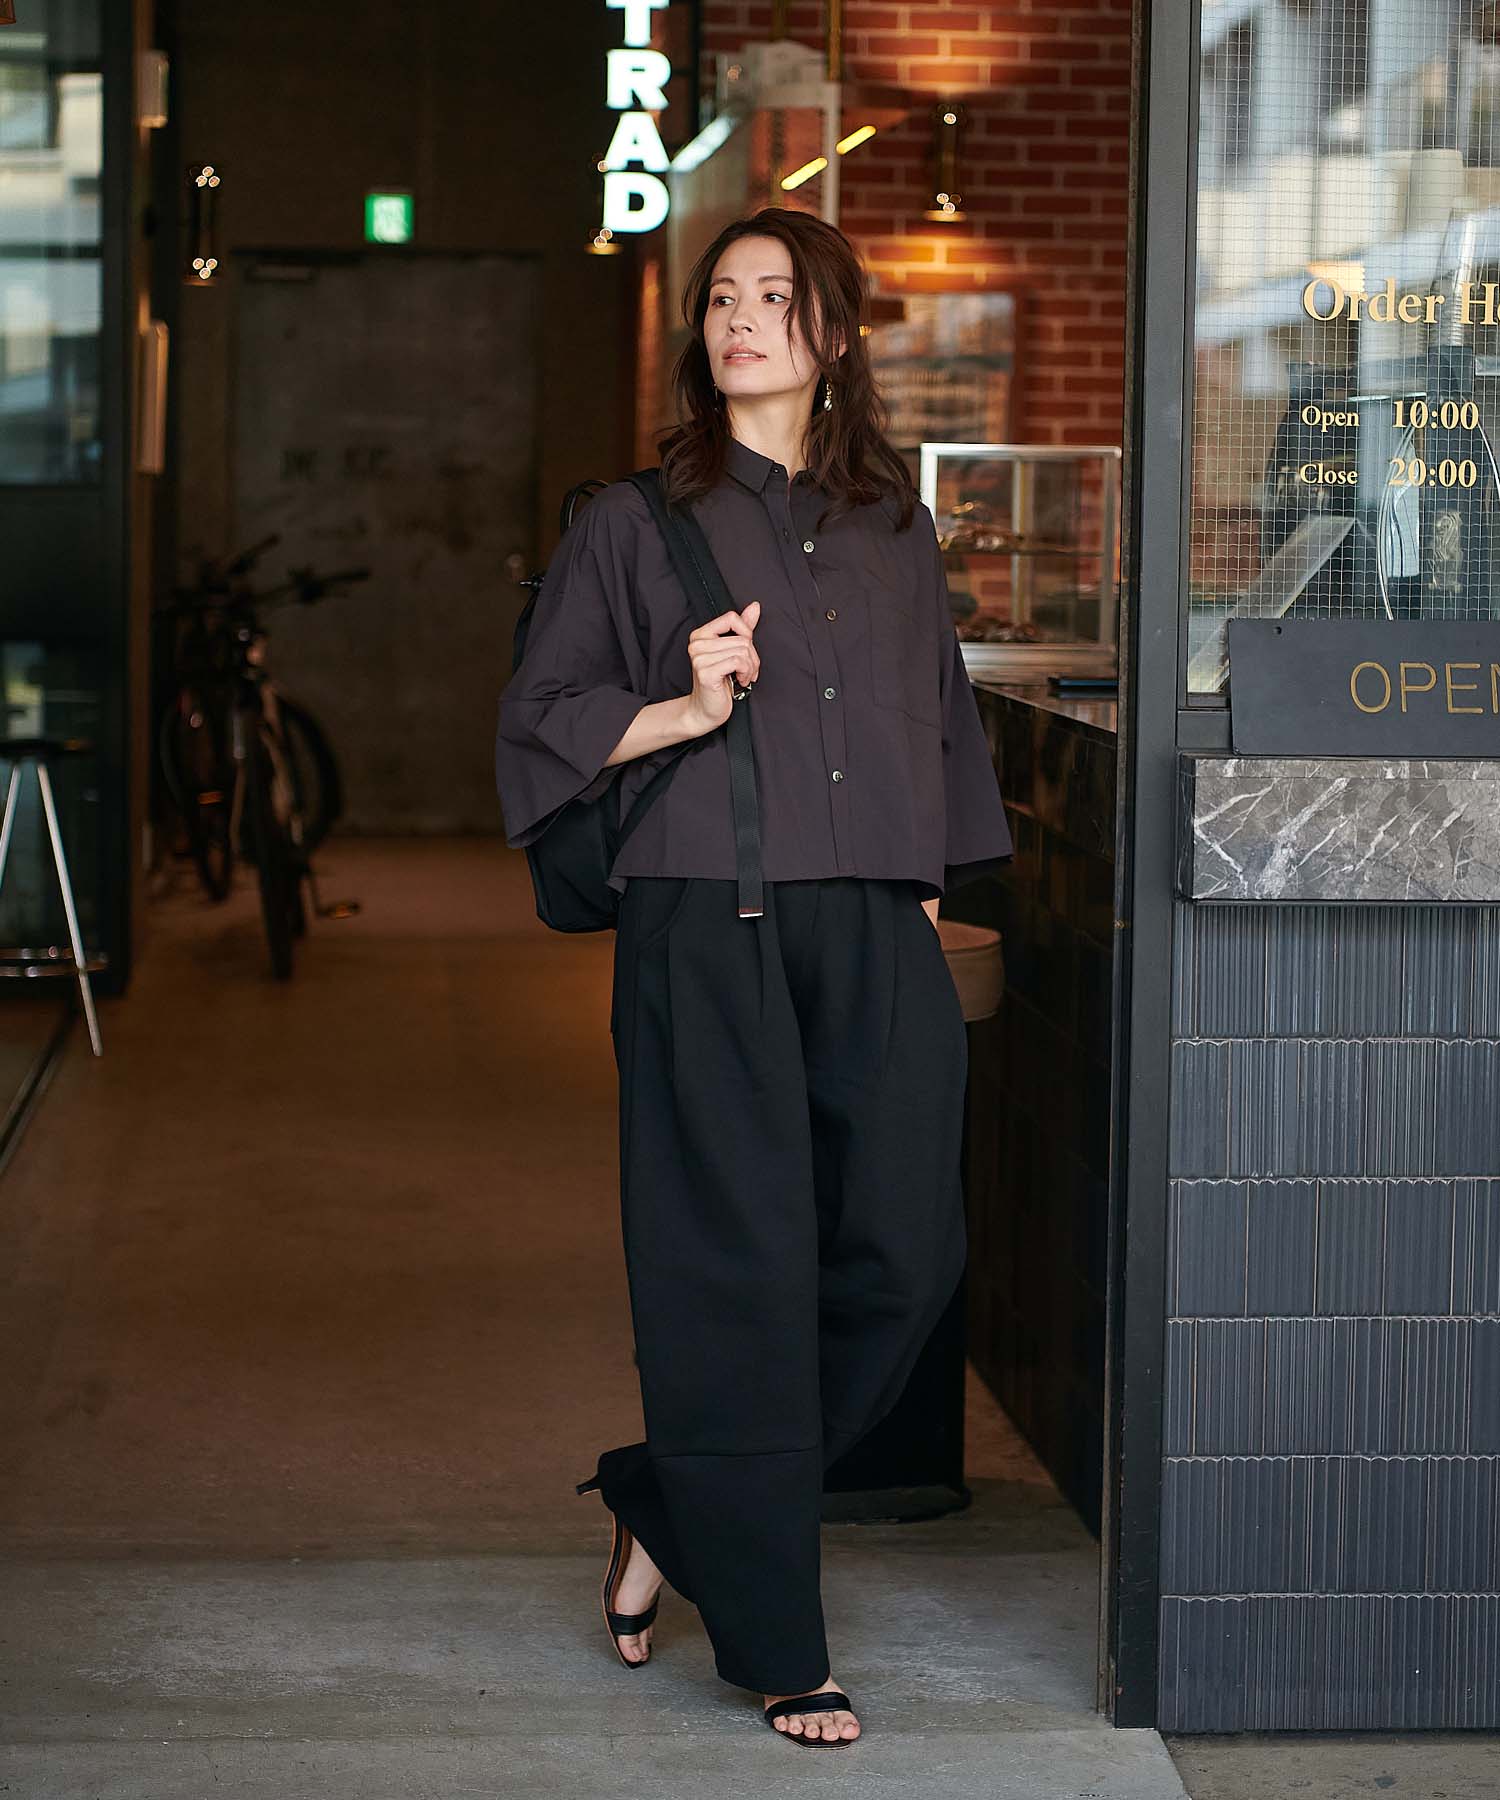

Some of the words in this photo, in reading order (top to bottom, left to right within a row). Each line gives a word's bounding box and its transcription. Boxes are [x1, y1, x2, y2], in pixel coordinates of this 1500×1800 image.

[604, 0, 671, 233] TRAD
[1303, 278, 1446, 324] Order
[1459, 282, 1500, 325] H
[1301, 405, 1360, 432] Open
[1392, 400, 1479, 430] 10:00
[1299, 463, 1359, 485] Close
[1388, 457, 1478, 487] 20:00
[1350, 661, 1500, 714] OPE
